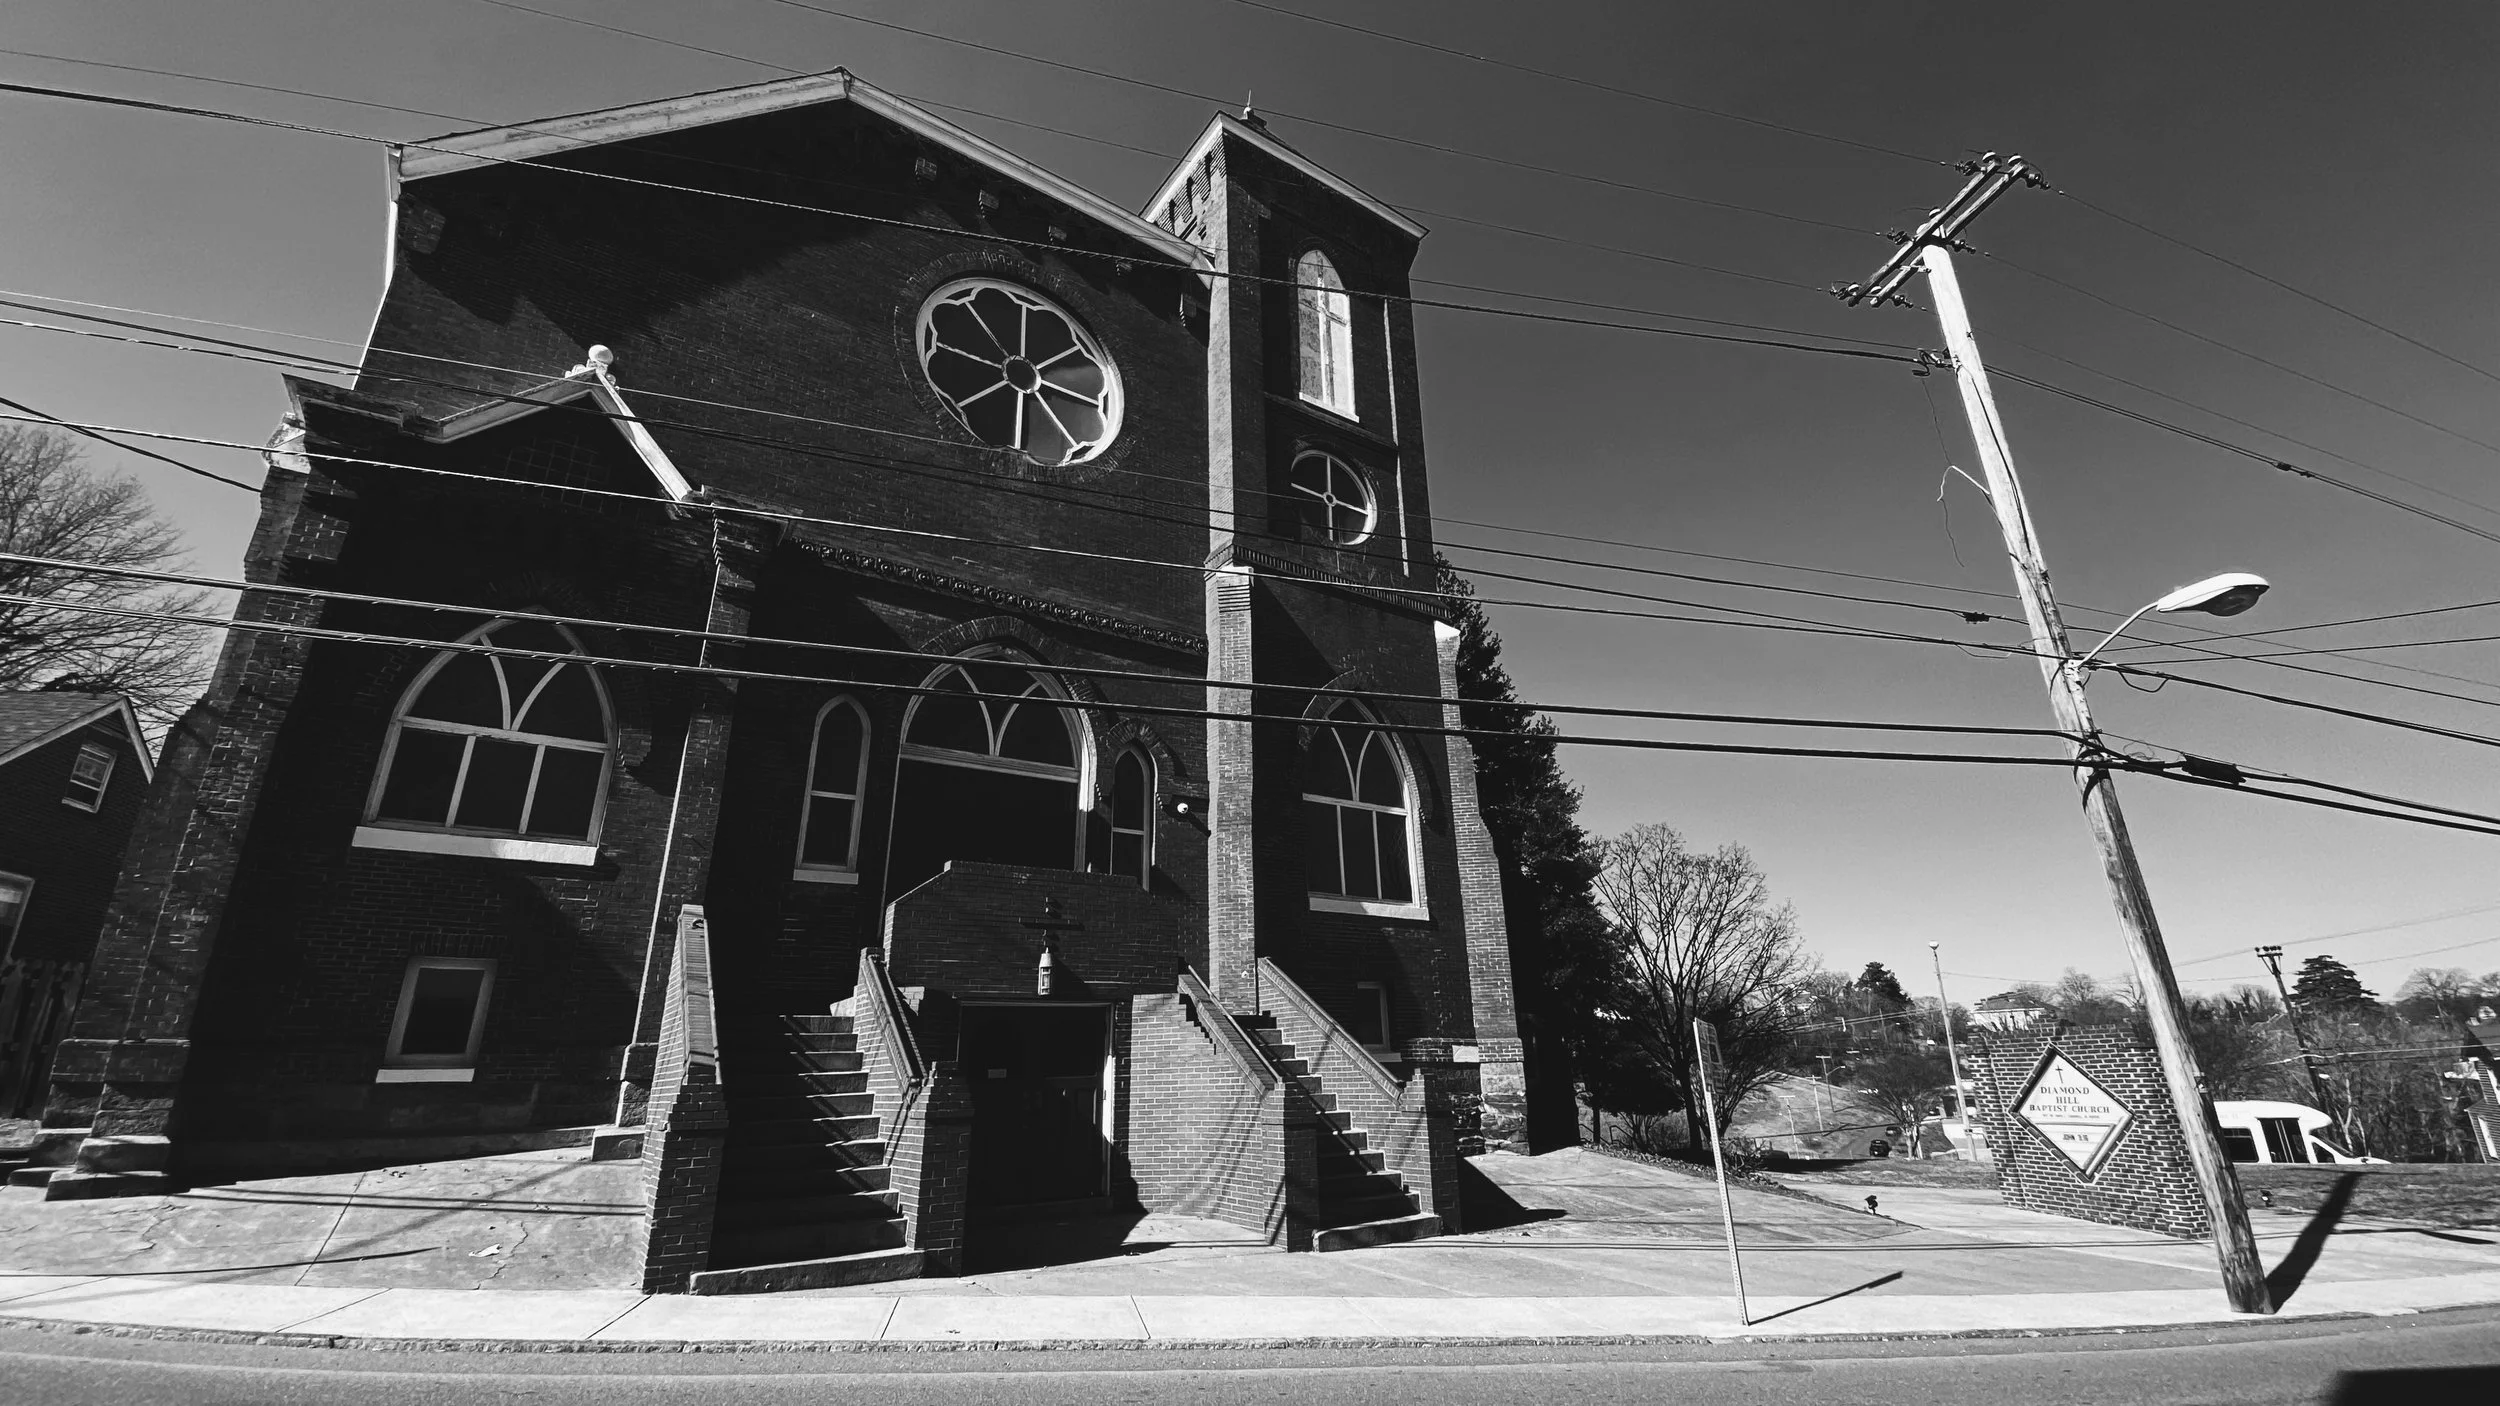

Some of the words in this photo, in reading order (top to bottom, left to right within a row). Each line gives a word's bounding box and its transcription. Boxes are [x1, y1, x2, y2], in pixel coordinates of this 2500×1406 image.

[2040, 1086, 2090, 1095] DIAMOND
[2056, 1096, 2079, 1104] HILL
[2029, 1104, 2067, 1112] BAPTIST
[2071, 1105, 2110, 1114] CHURCH
